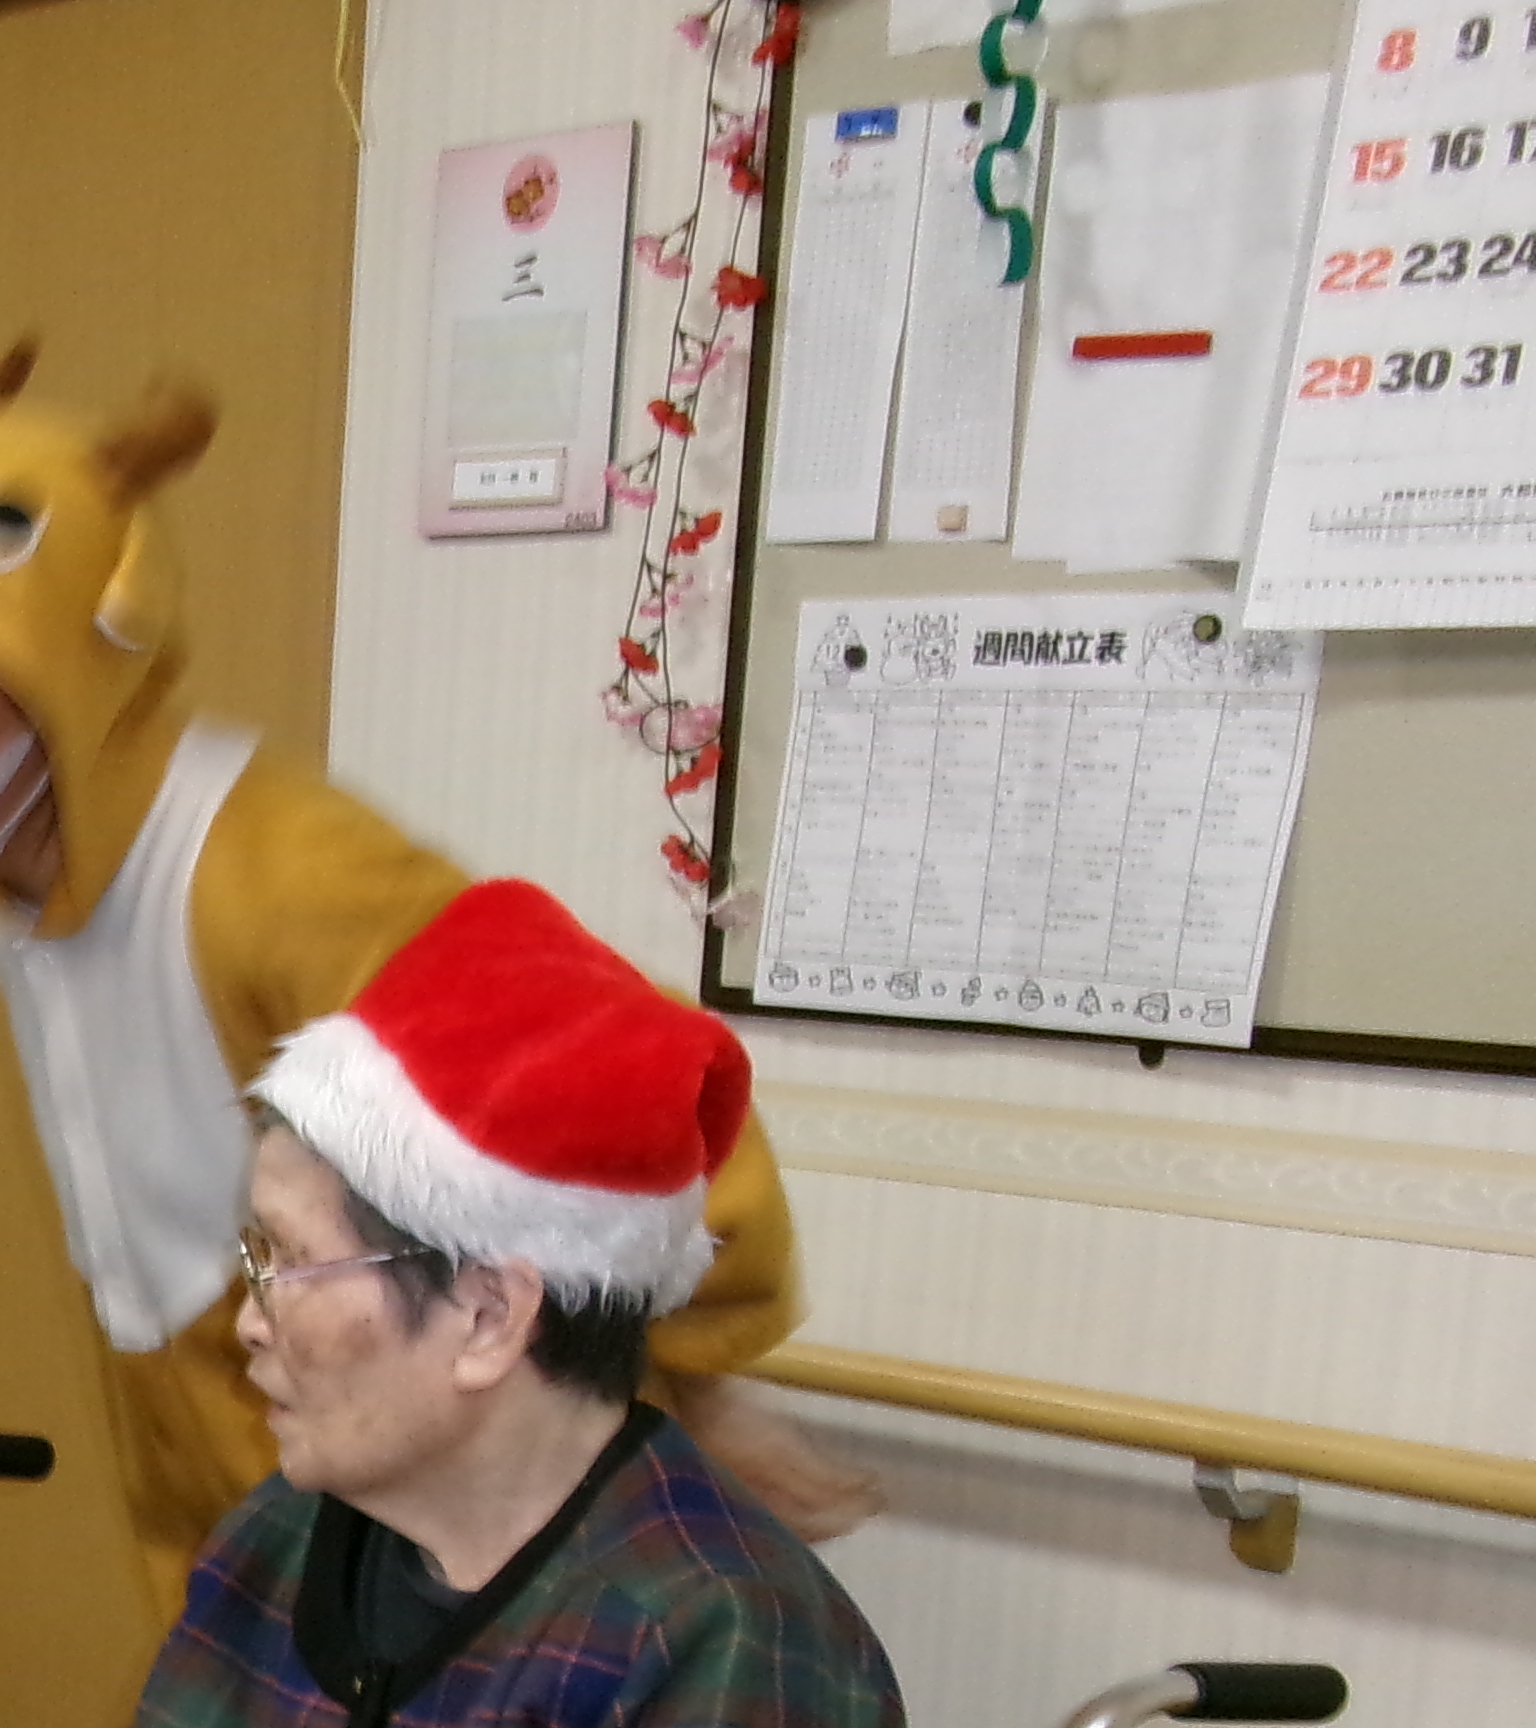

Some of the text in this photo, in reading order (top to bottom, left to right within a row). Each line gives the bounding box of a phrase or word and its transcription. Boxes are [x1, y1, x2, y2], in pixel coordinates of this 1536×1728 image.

[1378, 29, 1417, 72] 8
[1457, 16, 1493, 61] 9
[1352, 139, 1407, 182] 15
[1430, 128, 1486, 173] 16
[1319, 249, 1394, 292] 22
[1400, 240, 1471, 285] 23
[1299, 344, 1523, 399] 29 30 31
[973, 630, 1129, 666] 週間献立表
